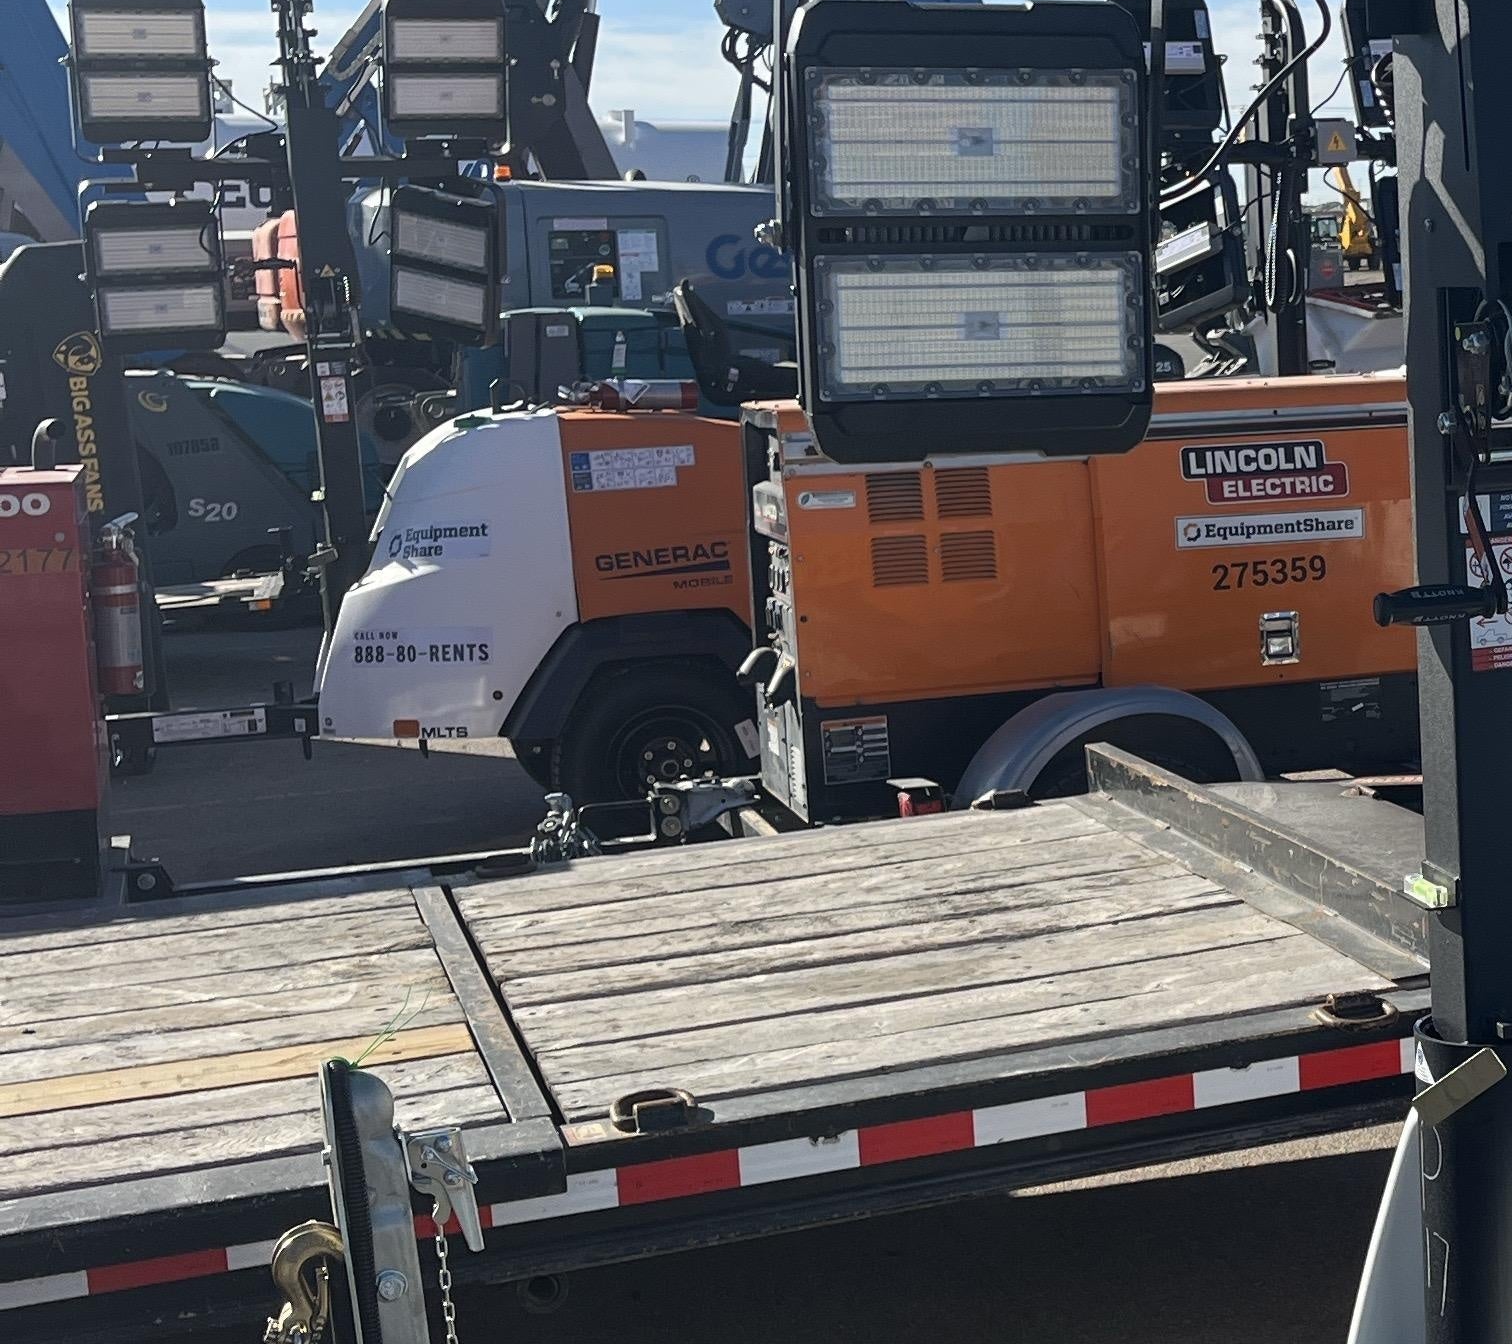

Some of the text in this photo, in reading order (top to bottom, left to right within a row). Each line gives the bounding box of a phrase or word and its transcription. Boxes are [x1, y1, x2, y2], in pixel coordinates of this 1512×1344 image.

[69, 376, 104, 512] BIG ASS FANS
[1188, 445, 1317, 476] LINCOLN
[1222, 474, 1335, 498] ELECTRIC
[187, 497, 238, 523] S20
[404, 522, 489, 543] Equipment
[1204, 517, 1355, 541] EquipmentShare
[402, 543, 444, 560] Share
[595, 541, 729, 572] GENERAC
[672, 575, 734, 590] MOBILE
[1211, 554, 1327, 591] 275359
[354, 631, 399, 641] CALL NOW
[354, 643, 490, 665] 888-80-RENTS
[421, 727, 469, 739] MLTS
